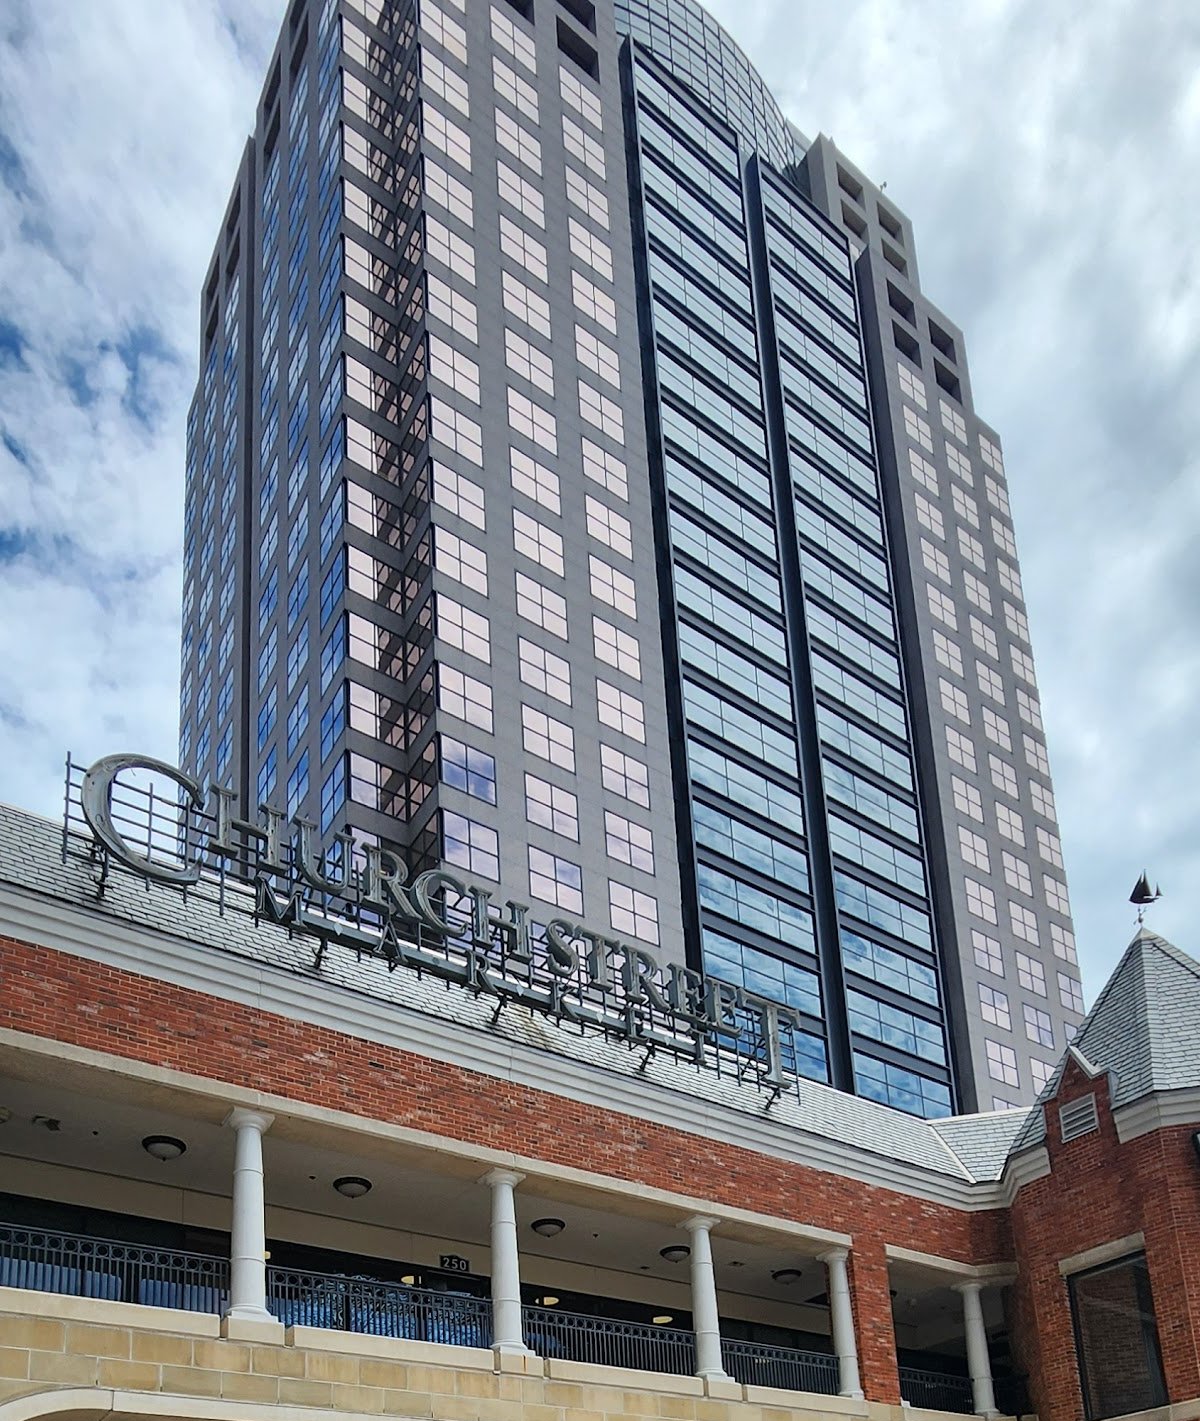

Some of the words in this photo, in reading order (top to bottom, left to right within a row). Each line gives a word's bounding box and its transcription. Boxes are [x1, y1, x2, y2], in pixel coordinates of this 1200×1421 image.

[81, 753, 533, 961] CHURCH
[545, 917, 800, 1090] STREET
[253, 874, 711, 1067] MARKET
[443, 1257, 467, 1271] 250
